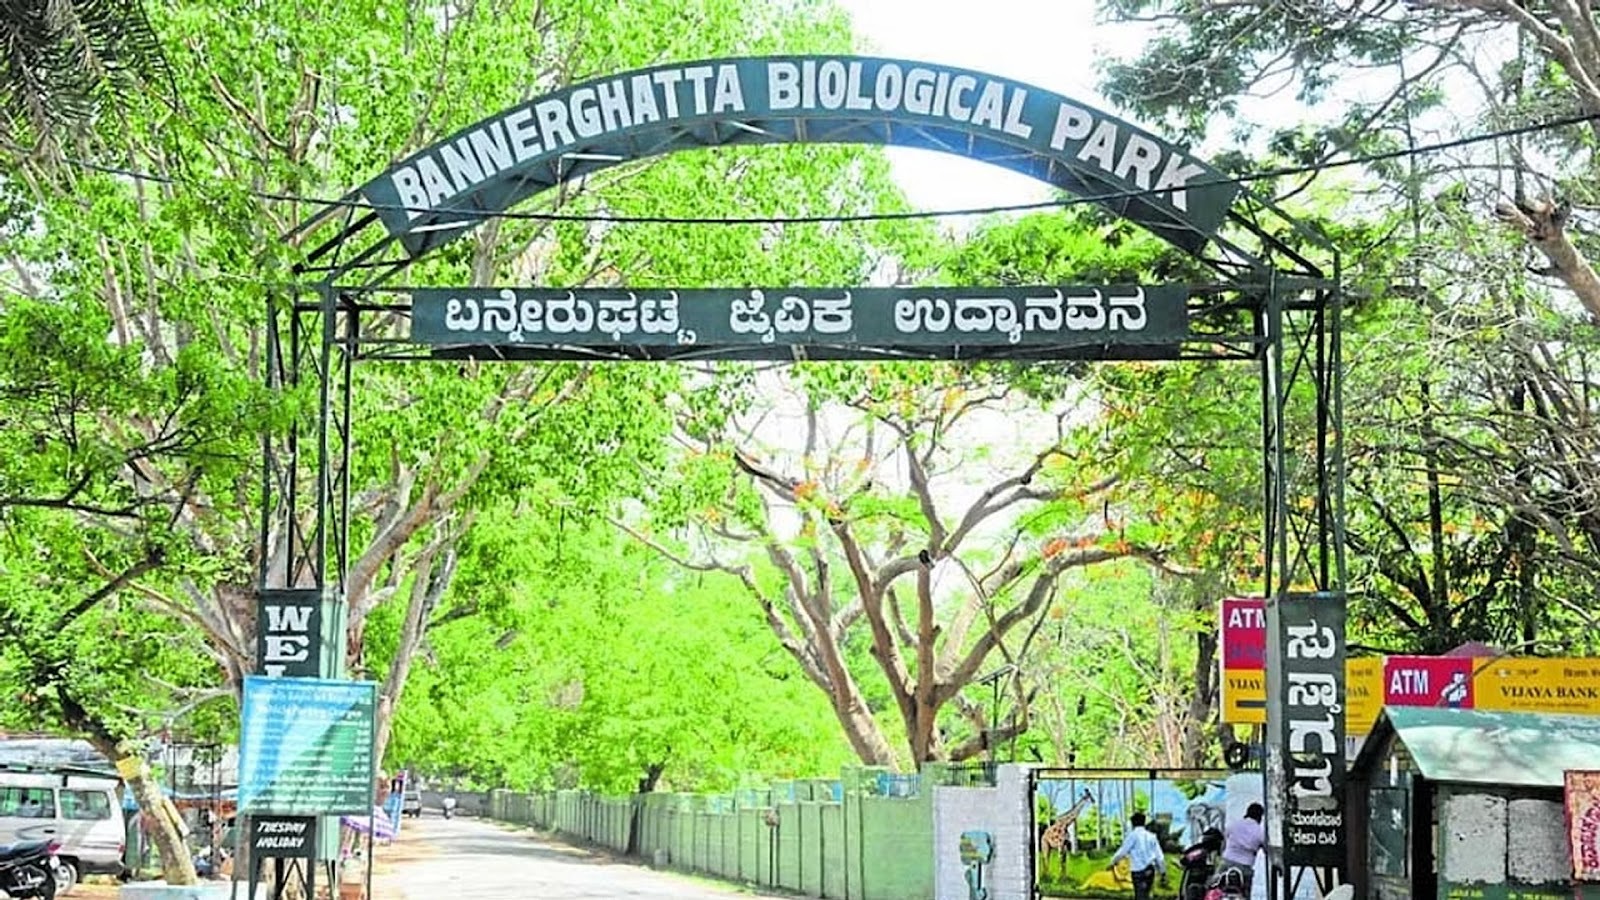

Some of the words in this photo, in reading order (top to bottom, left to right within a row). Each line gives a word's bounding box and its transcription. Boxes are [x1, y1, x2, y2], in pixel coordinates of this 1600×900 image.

[390, 63, 745, 221] BANNERGHATTA
[767, 60, 1032, 139] BIOLOGICAL
[1050, 102, 1206, 212] PARK
[730, 289, 852, 343] ಜೈವಿಕ
[894, 286, 1147, 344] ಉದ್ಯಾನವನ
[1228, 678, 1265, 690] VIJAY
[1390, 669, 1429, 695] ATM
[1501, 685, 1552, 698] VIJAYA
[1557, 686, 1598, 699] BANK
[257, 821, 307, 834] TUESDAY
[255, 836, 305, 848] HOLIDAY
